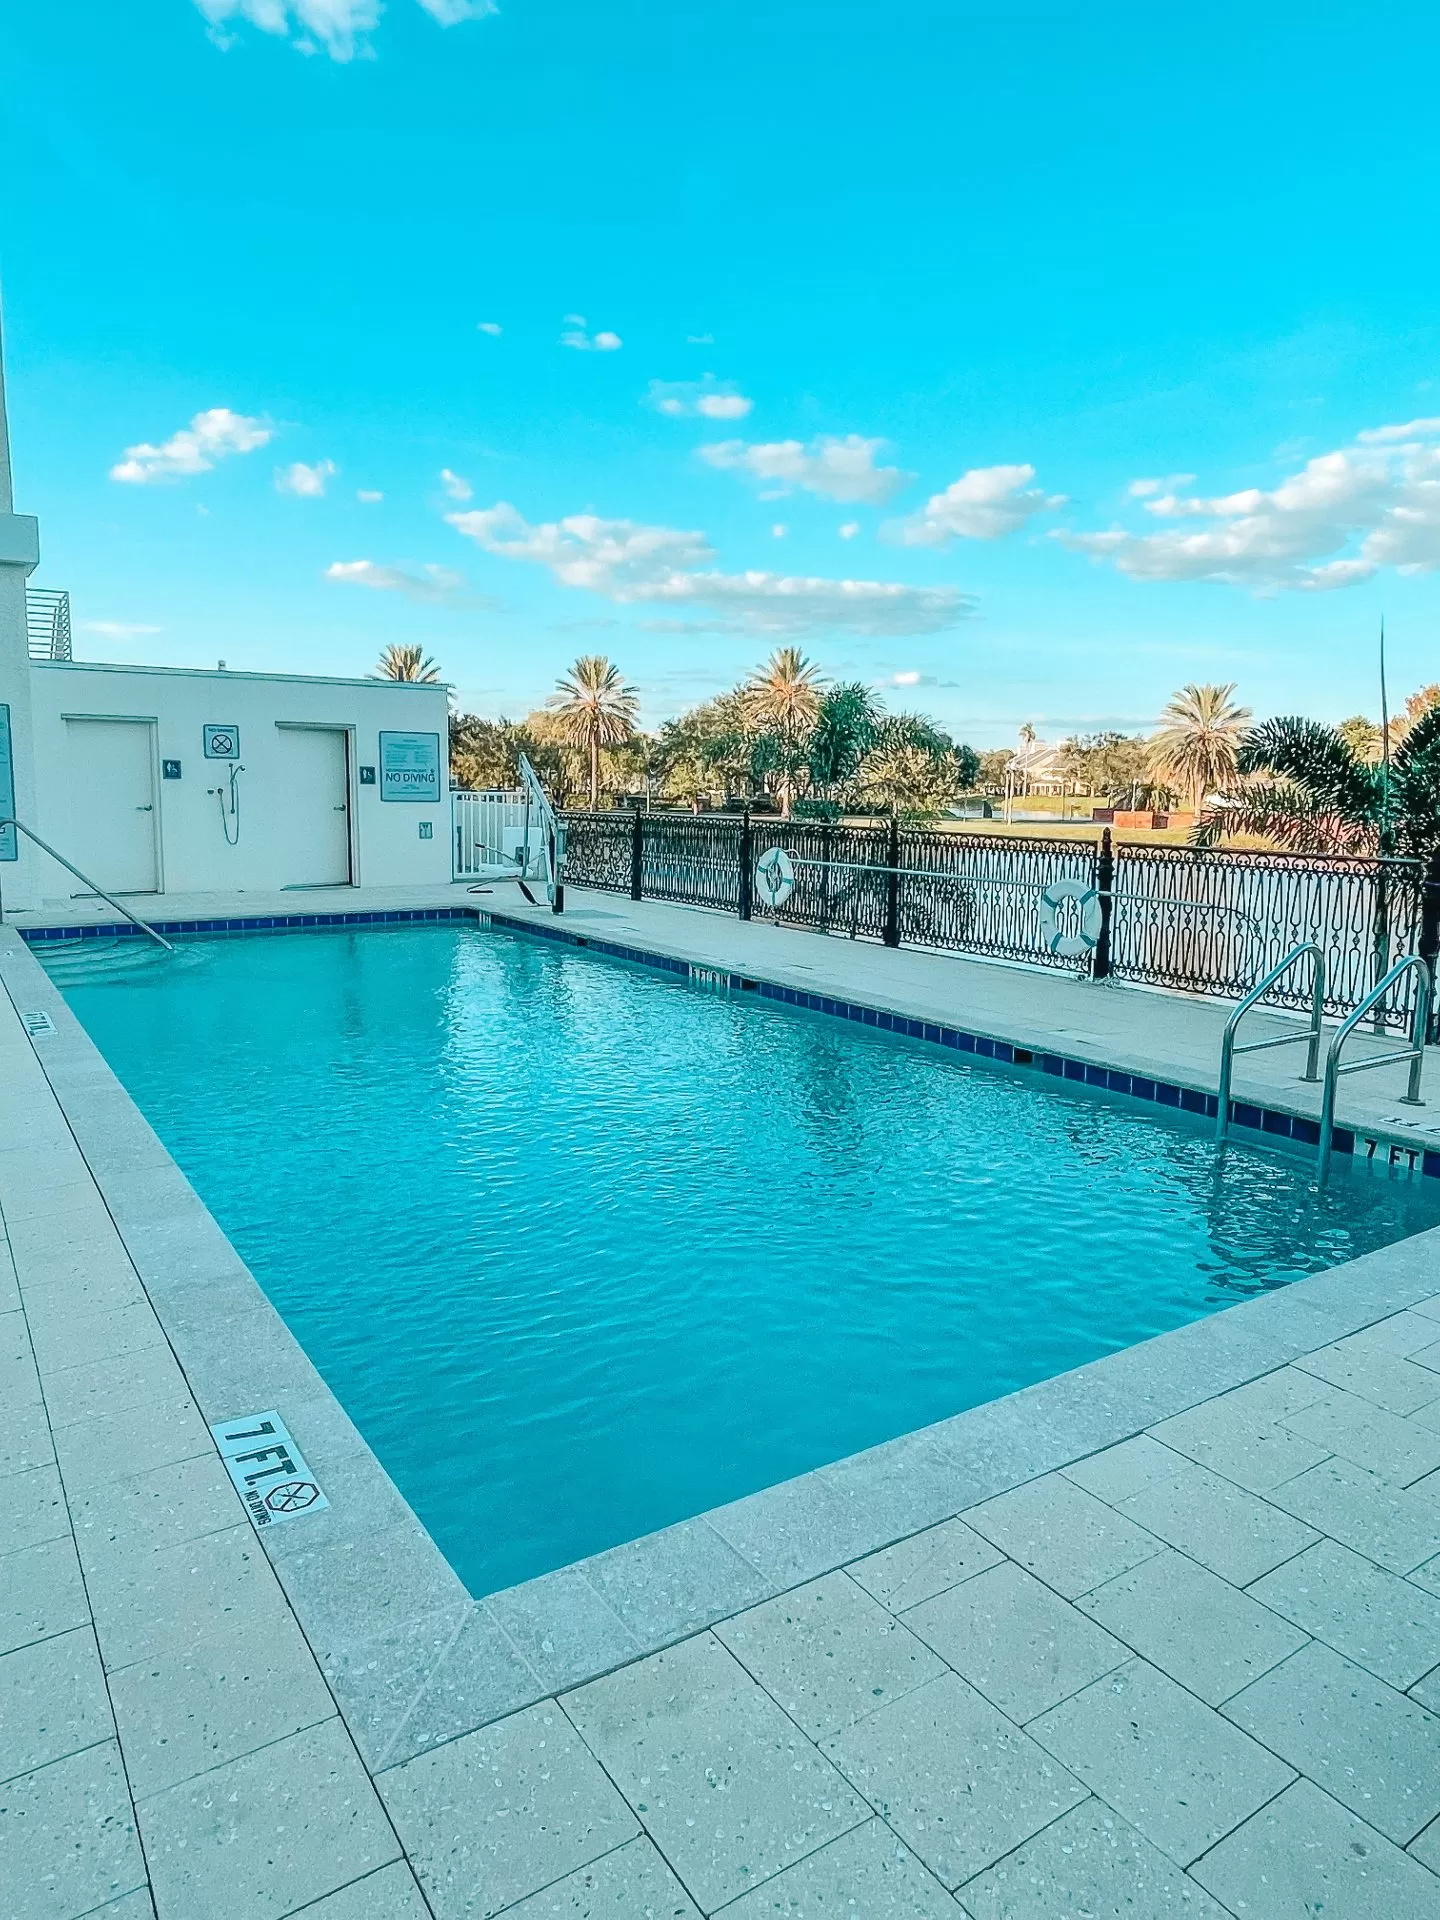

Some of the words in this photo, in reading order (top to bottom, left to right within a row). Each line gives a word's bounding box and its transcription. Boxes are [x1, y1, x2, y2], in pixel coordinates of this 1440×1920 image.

[386, 773, 400, 782] NO
[403, 773, 435, 783] DIVING
[1365, 1138, 1378, 1158] 7
[1388, 1145, 1420, 1171] FT
[225, 1421, 276, 1440] 7
[244, 1490, 260, 1501] NO
[249, 1500, 271, 1525] DIVING
